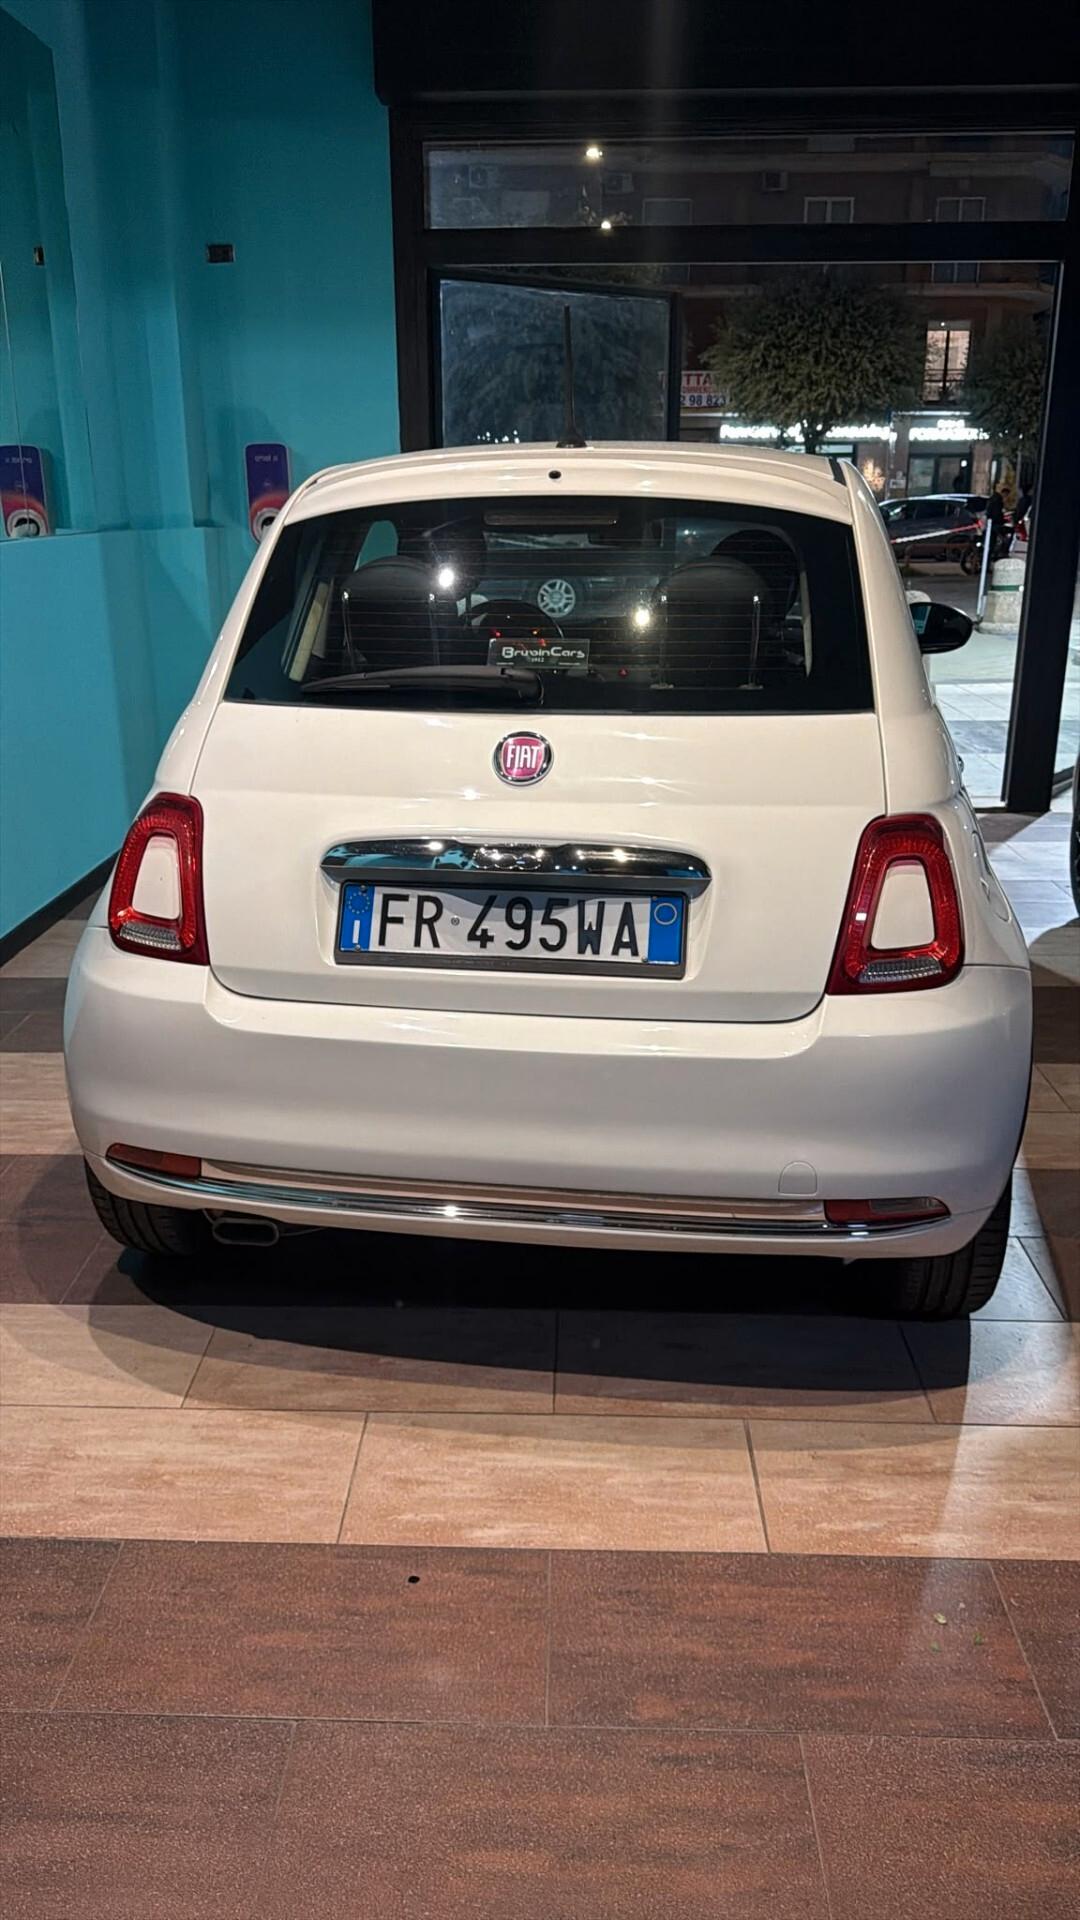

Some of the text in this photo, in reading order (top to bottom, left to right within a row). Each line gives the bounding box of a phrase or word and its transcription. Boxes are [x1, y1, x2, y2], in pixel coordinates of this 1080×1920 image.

[689, 394, 703, 406] 98
[506, 745, 540, 769] FIAT
[378, 893, 444, 948] FR
[467, 895, 640, 957] 495WA
